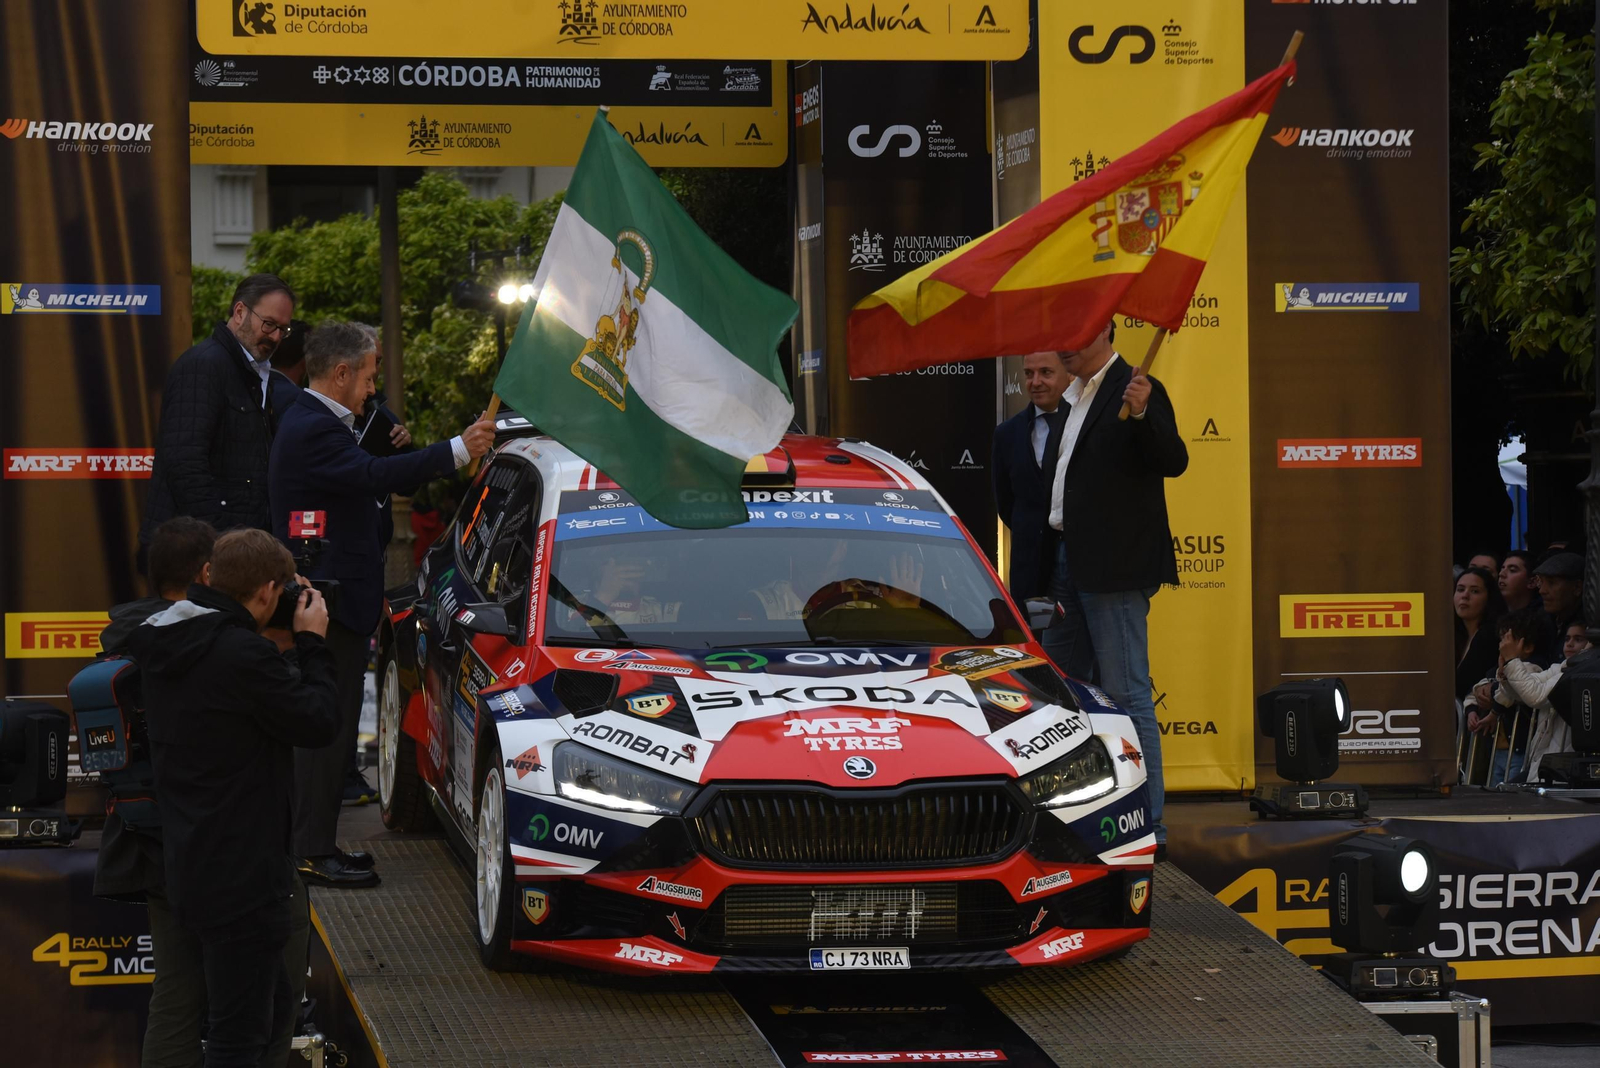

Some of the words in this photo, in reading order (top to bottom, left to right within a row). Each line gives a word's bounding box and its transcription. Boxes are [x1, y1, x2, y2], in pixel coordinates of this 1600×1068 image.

[284, 3, 367, 20] Diputación
[602, 4, 687, 18] AYUNTAMIENTO
[801, 3, 931, 34] Andalucía
[284, 20, 302, 34] de
[307, 20, 368, 34] Córdoba
[602, 22, 616, 36] DE
[619, 19, 673, 36] CÓRDOBA
[1165, 40, 1197, 50] Consejo
[1165, 48, 1199, 58] Superior
[1165, 57, 1174, 65] de
[1176, 57, 1214, 66] Deportes
[398, 61, 521, 87] CÓRDOBA
[526, 66, 592, 77] PATRIMONIO
[526, 77, 601, 88] HUMANIDAD
[803, 84, 819, 110] ENEOS
[189, 123, 254, 137] Diputación
[443, 123, 512, 135] AYUNTAMIENTO
[608, 122, 709, 146] ndalucía
[189, 136, 203, 148] de
[206, 135, 255, 148] Córdoba
[443, 137, 455, 149] DE
[457, 135, 501, 149] CÓRDOBA
[928, 136, 954, 145] Consejo
[57, 141, 99, 155] driving
[101, 143, 152, 154] emotion
[928, 144, 956, 152] Superior
[1326, 147, 1364, 160] driving
[1366, 147, 1412, 158] emotion
[894, 250, 906, 263] DE
[47, 294, 148, 306] MICHELIN
[1316, 291, 1408, 304] MICHELIN
[1282, 446, 1347, 462] MRF
[1352, 444, 1417, 460] TYRES
[8, 456, 82, 472] MRF
[86, 456, 155, 472] TYRES
[1173, 536, 1225, 554] ASUS
[532, 564, 542, 593] RALLY
[528, 594, 538, 638] ACADEMY
[1293, 602, 1412, 630] PIRELLI
[21, 621, 113, 649] PIRE
[784, 652, 917, 667] OMV
[630, 662, 692, 674] AUGSBURG
[636, 698, 666, 710] BT
[692, 686, 977, 711] SKODA
[994, 692, 1021, 704] BT
[784, 718, 912, 737] MRF
[1157, 721, 1218, 735] VEGA
[572, 722, 690, 766] ROMBAT
[804, 736, 903, 751] TYRES
[1016, 716, 1088, 759] ROMBAT
[505, 758, 546, 772] NRF
[1118, 808, 1145, 834] OMV
[554, 823, 604, 850] OMV
[1035, 870, 1070, 888] AUGSBURG
[656, 882, 702, 898] AUGSBURG
[1134, 886, 1146, 900] BT
[526, 895, 544, 908] BT
[72, 936, 133, 950] RALLY
[1038, 932, 1085, 959] MRF
[614, 942, 683, 966] MRF
[825, 952, 846, 968] CJ
[850, 952, 869, 967] 73
[872, 952, 904, 966] NRA
[811, 1052, 900, 1062] MRF
[906, 1050, 998, 1060] TYRES
